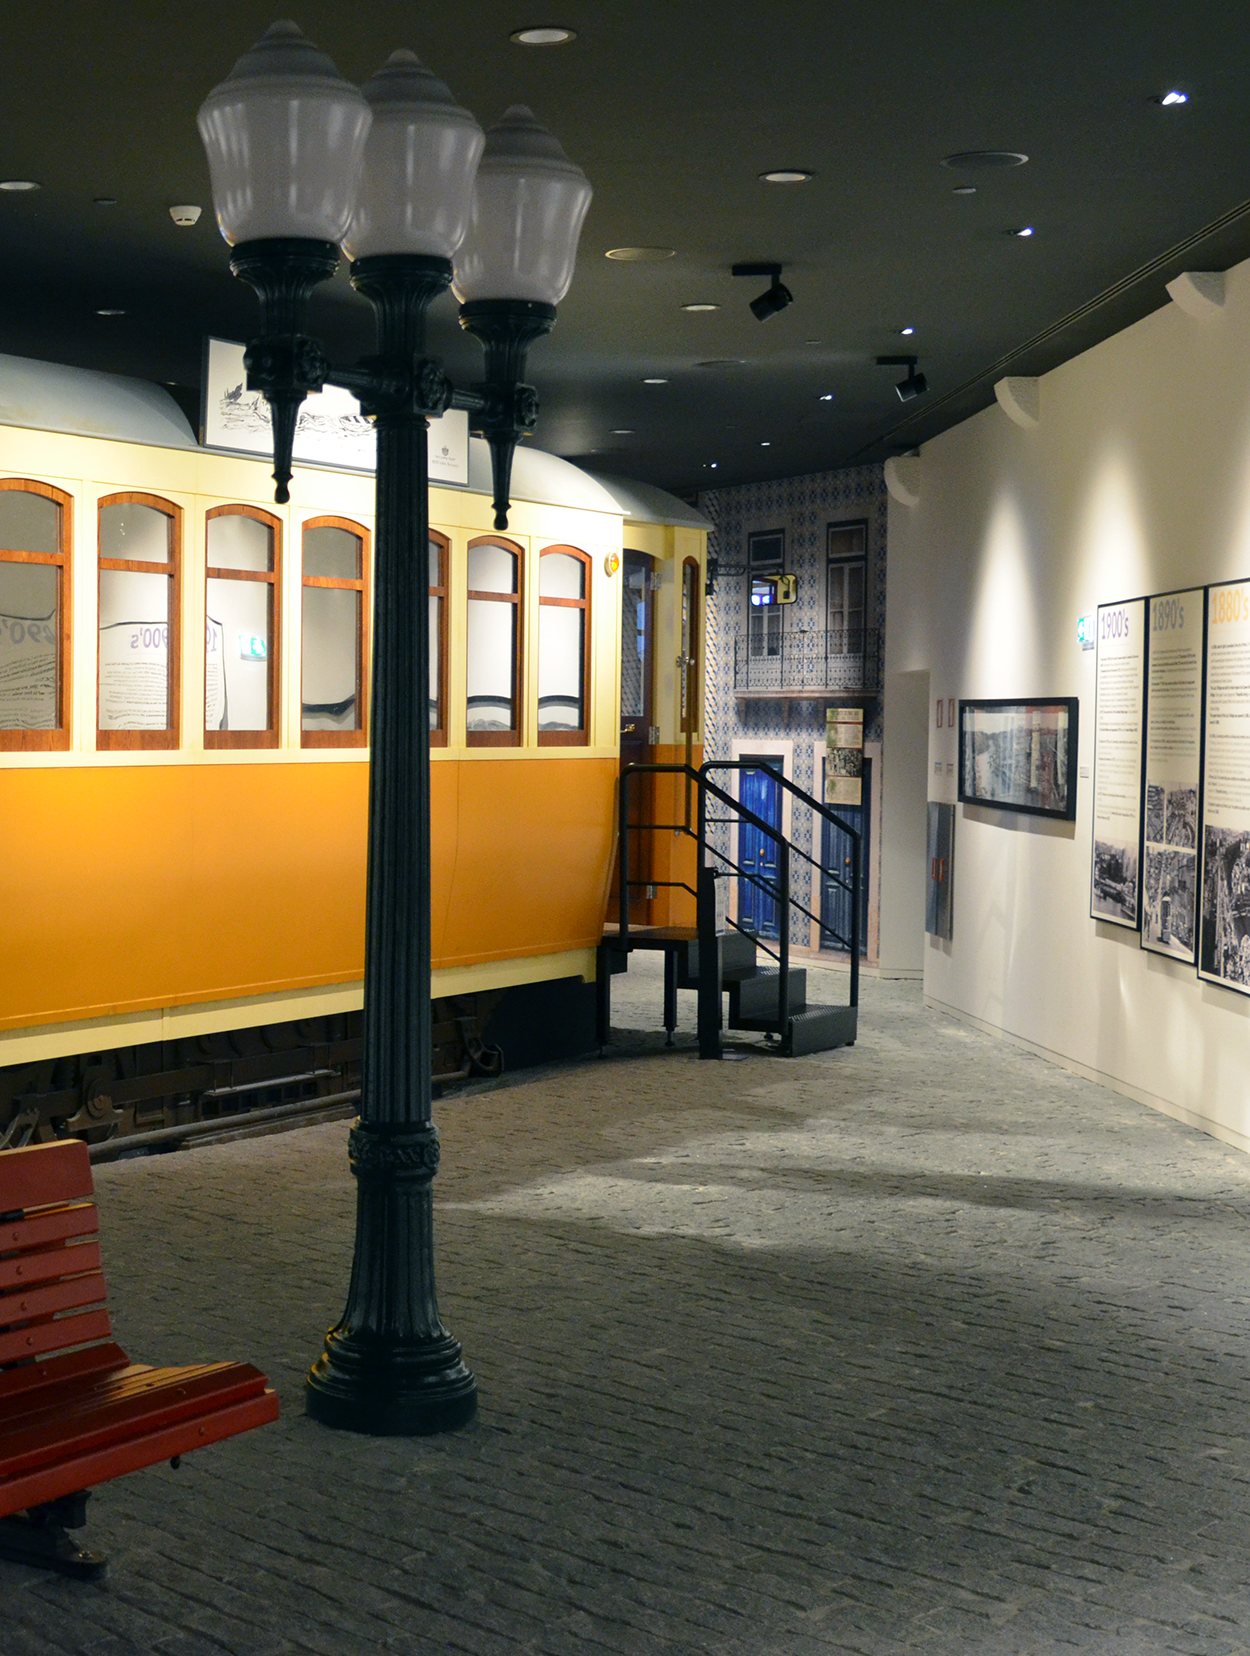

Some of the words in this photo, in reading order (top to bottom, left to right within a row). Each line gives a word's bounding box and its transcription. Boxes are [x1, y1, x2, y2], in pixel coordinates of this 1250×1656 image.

[1152, 598, 1185, 632] 1890's
[1212, 587, 1249, 625] 1880's
[1102, 609, 1129, 640] 1900's
